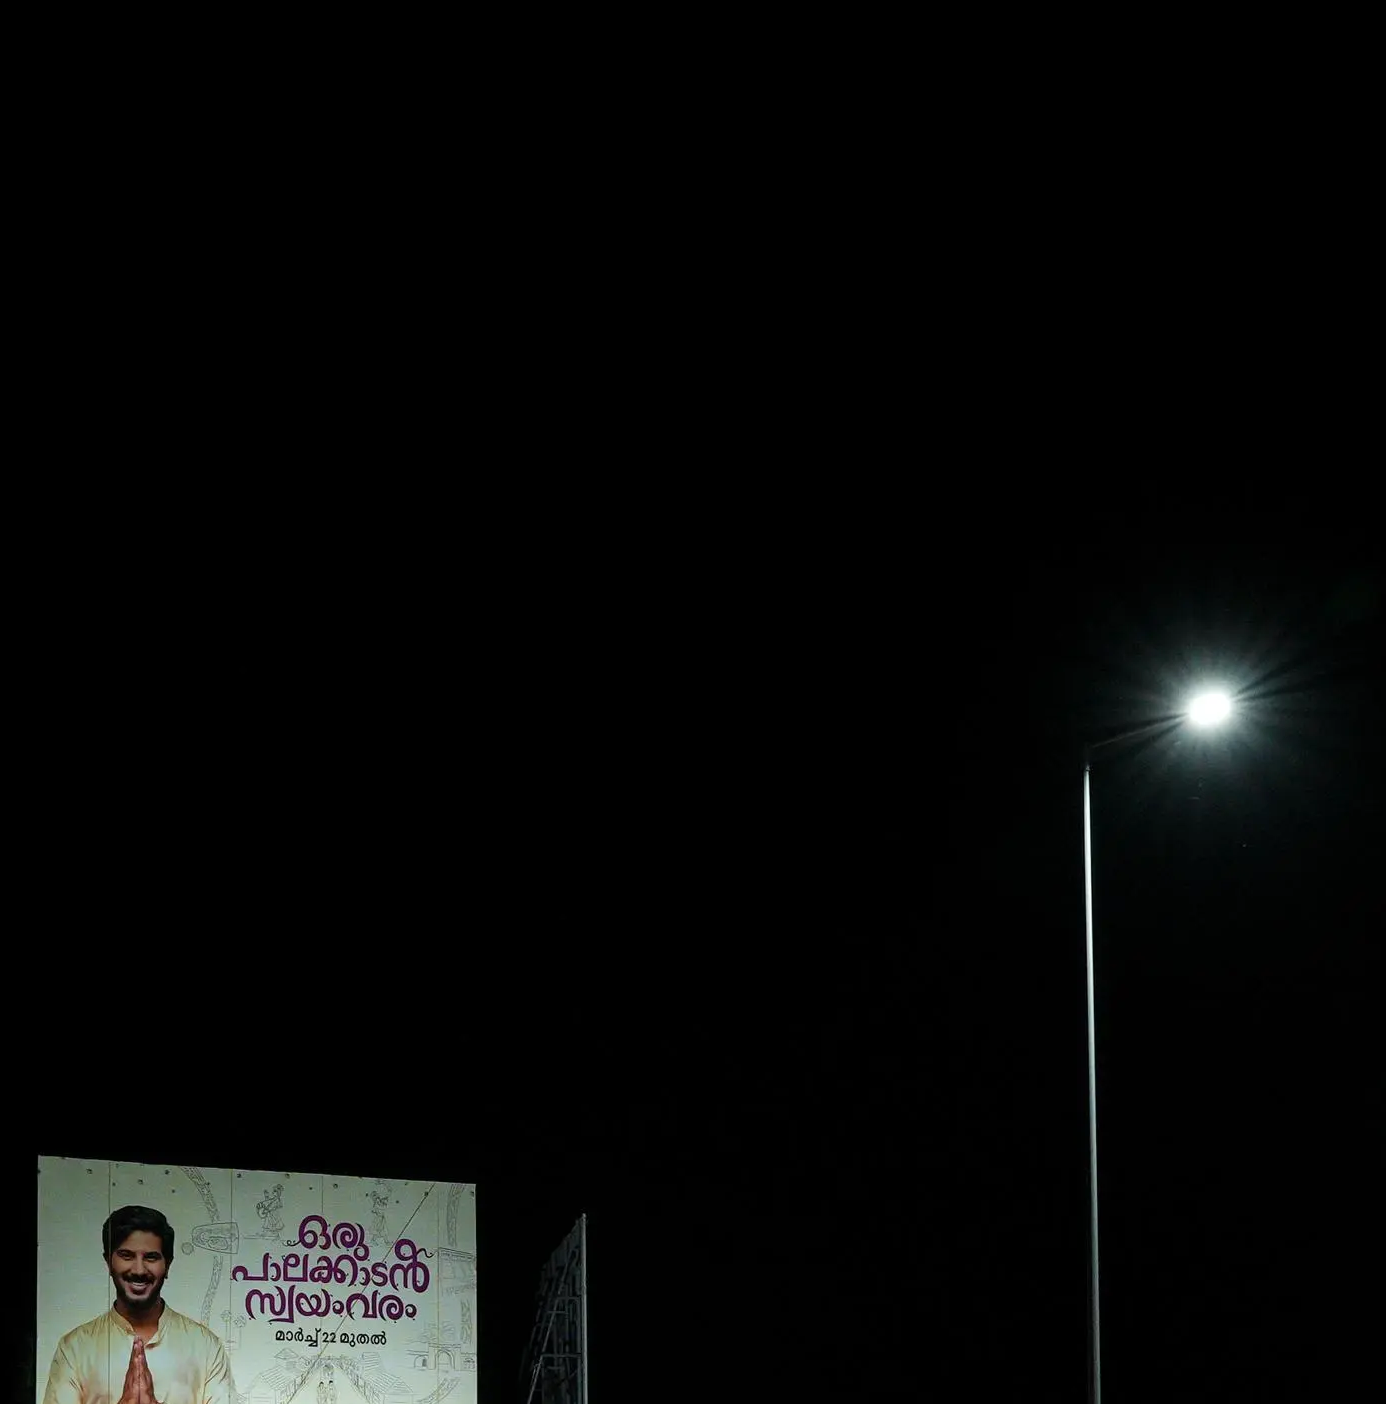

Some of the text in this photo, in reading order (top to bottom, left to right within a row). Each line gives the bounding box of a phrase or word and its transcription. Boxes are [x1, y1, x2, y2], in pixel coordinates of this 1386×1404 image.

[282, 1215, 370, 1261] ഒരു
[245, 1285, 418, 1323] സ്വയംവരം
[322, 1331, 336, 1343] 22
[340, 1330, 387, 1347] മുതൽ
